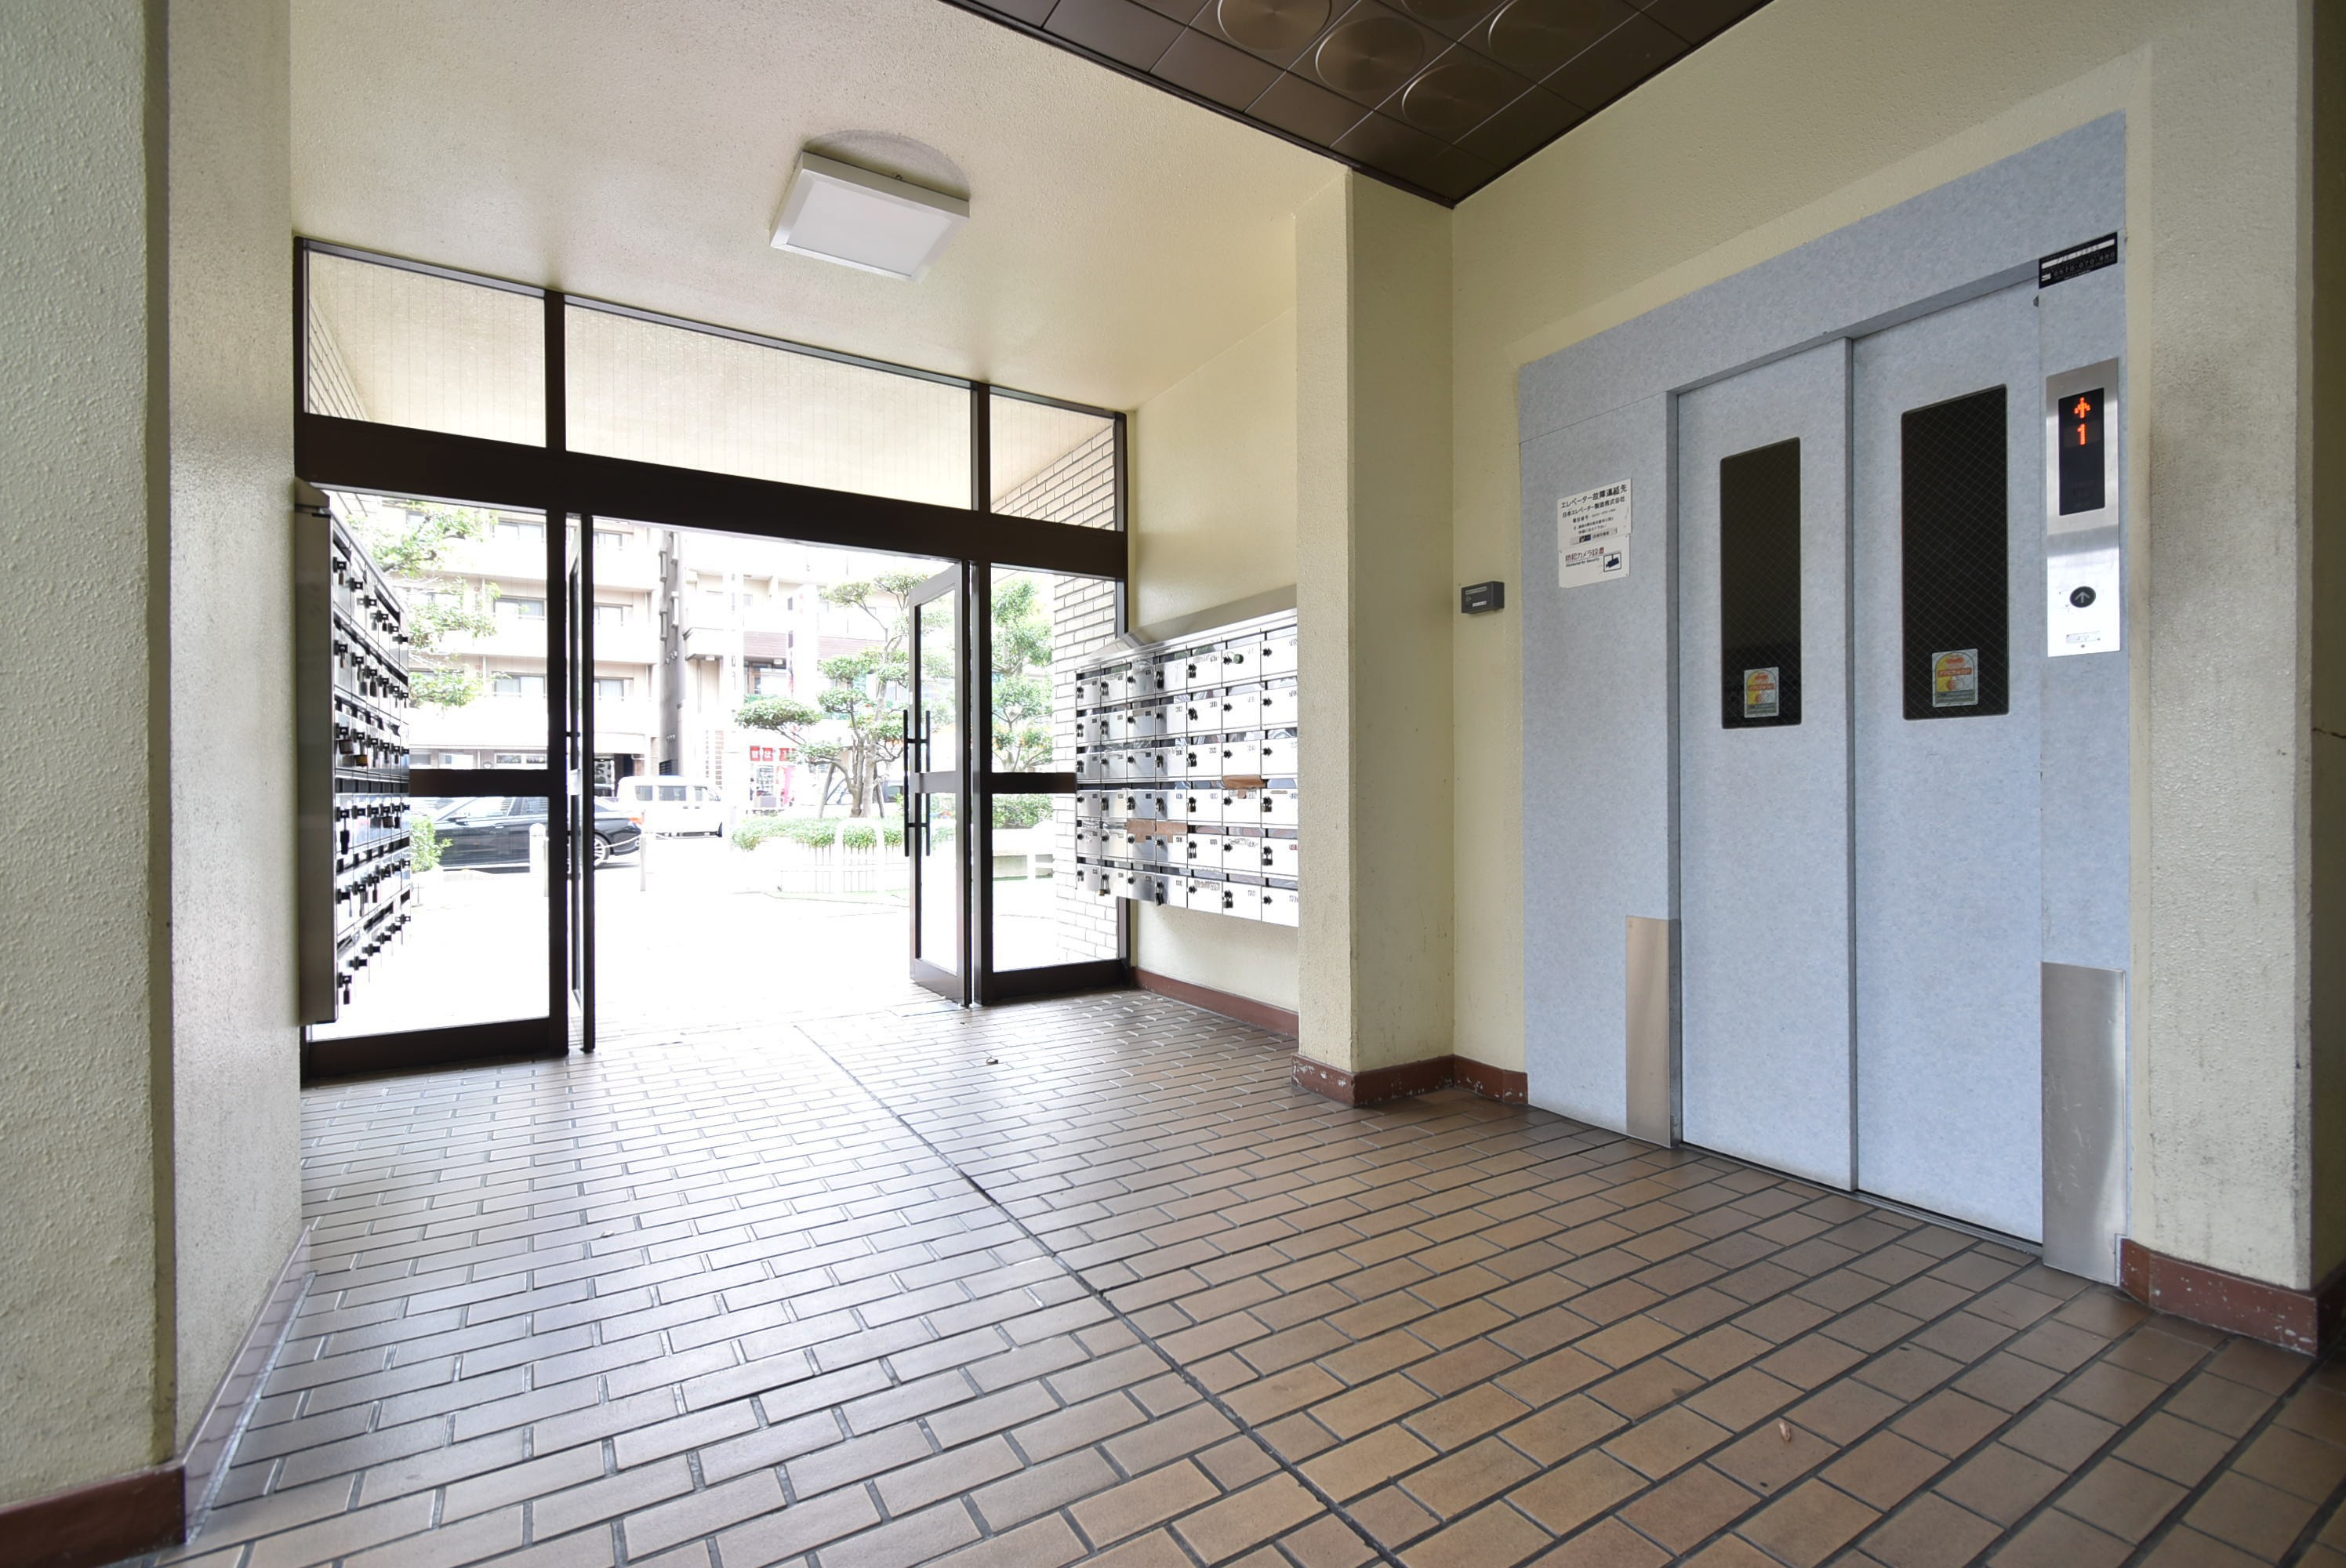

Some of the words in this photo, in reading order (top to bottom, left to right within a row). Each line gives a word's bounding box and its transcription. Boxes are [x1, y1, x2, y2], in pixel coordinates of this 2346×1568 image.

[2077, 423, 2086, 445] 1
[1565, 546, 1604, 562] 防犯カメラ設置
